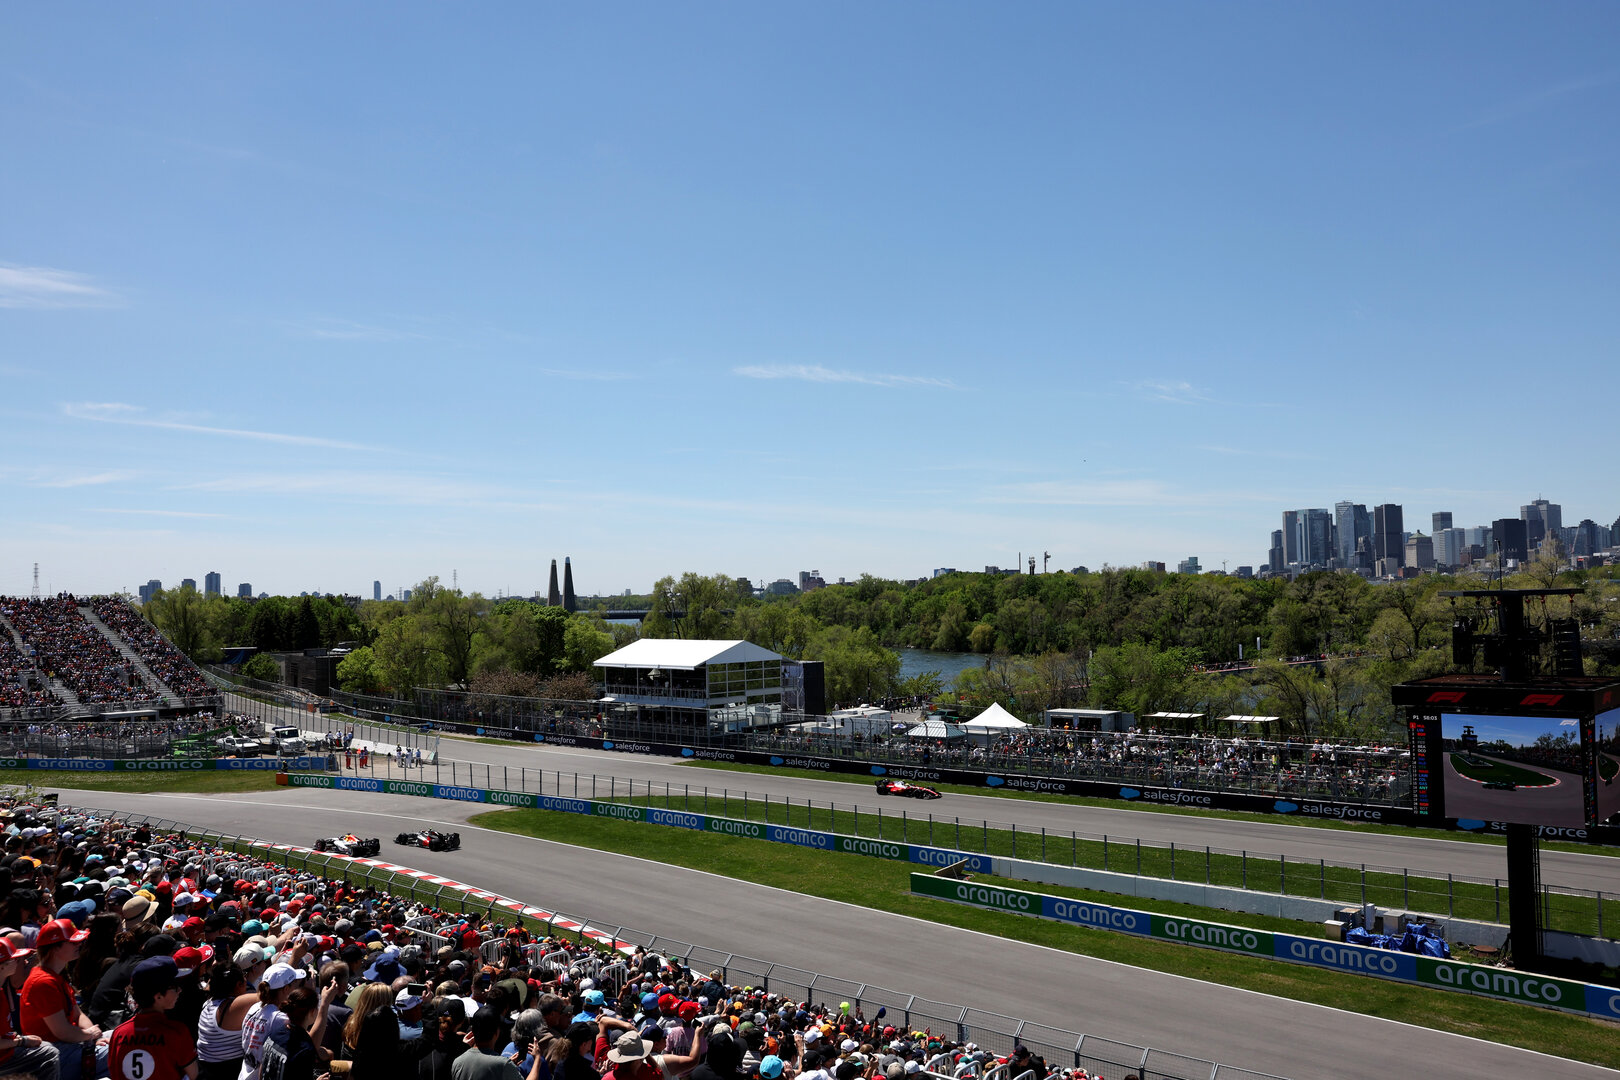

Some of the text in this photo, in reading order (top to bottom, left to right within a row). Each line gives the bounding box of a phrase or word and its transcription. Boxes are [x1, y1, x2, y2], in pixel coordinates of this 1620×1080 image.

[434, 722, 456, 731] salesforce
[486, 730, 512, 738] salesforce
[546, 736, 576, 745] salesforce
[616, 742, 650, 752] salesforce
[695, 750, 734, 760] salesforce
[38, 760, 106, 770] aramco
[125, 760, 203, 770] aramco
[786, 758, 830, 769] salesforce
[889, 768, 939, 779] salesforce
[293, 775, 330, 786] aramco
[340, 778, 378, 790] aramco
[1007, 779, 1066, 791] salesforce
[389, 782, 427, 794] aramco
[440, 786, 479, 799] aramco
[491, 791, 532, 804] aramco
[1144, 790, 1211, 804] salesforce
[544, 797, 584, 811] aramco
[597, 803, 640, 819] aramco
[1303, 804, 1381, 819] salesforce
[653, 810, 698, 826] aramco
[711, 819, 760, 836] aramco
[1490, 821, 1587, 838] saforce
[775, 828, 826, 846] aramco
[843, 839, 899, 858] aramco
[956, 884, 1031, 910] aramco
[1055, 901, 1136, 930] aramco
[1164, 920, 1258, 950] aramco
[1290, 940, 1397, 973] aramco
[1436, 964, 1562, 1002] aramco
[117, 1034, 165, 1046] CANADA
[132, 1053, 143, 1078] 5
